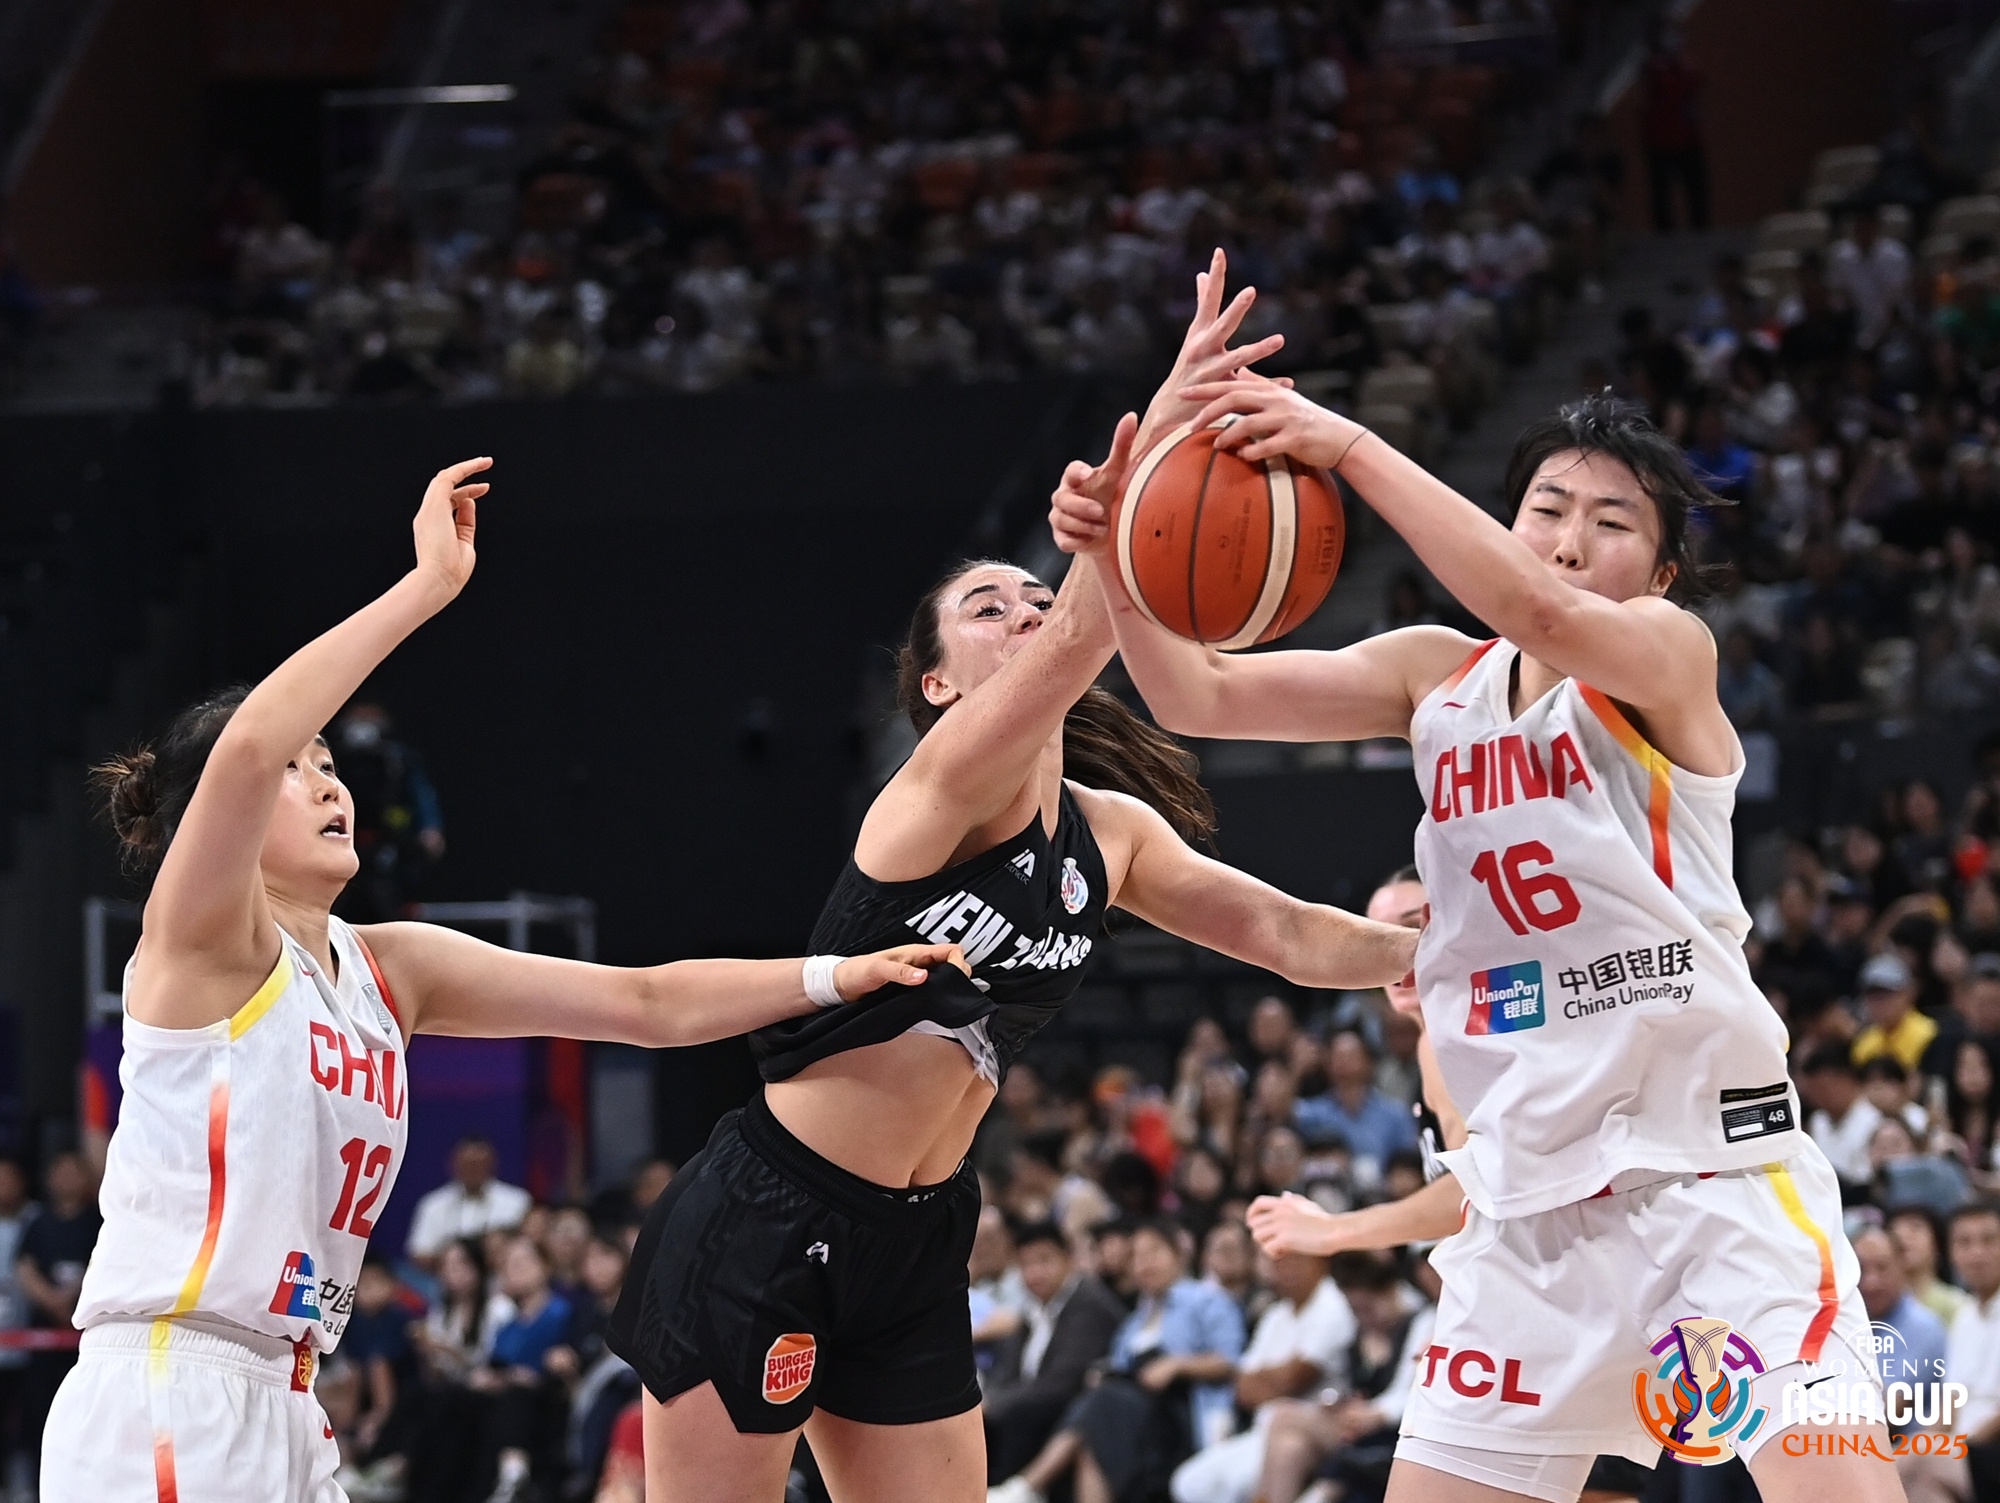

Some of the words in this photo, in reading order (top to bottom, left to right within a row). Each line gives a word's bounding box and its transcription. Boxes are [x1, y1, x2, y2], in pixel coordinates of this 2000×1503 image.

[1431, 731, 1594, 823] CHINA
[1470, 840, 1582, 936] 16
[904, 890, 1014, 967] NEW
[1558, 938, 1695, 996] 中国银联
[1473, 979, 1541, 1005] UnionPay
[1503, 999, 1539, 1019] 银联
[1563, 995, 1617, 1020] China
[1618, 982, 1695, 1005] UnionPay
[1768, 1109, 1786, 1123] 48
[329, 1137, 393, 1239] 12
[282, 1265, 315, 1287] Union
[318, 1278, 356, 1315] 中国
[766, 1363, 812, 1391] KING
[768, 1349, 814, 1372] BURGER
[1421, 1345, 1541, 1406] TCL
